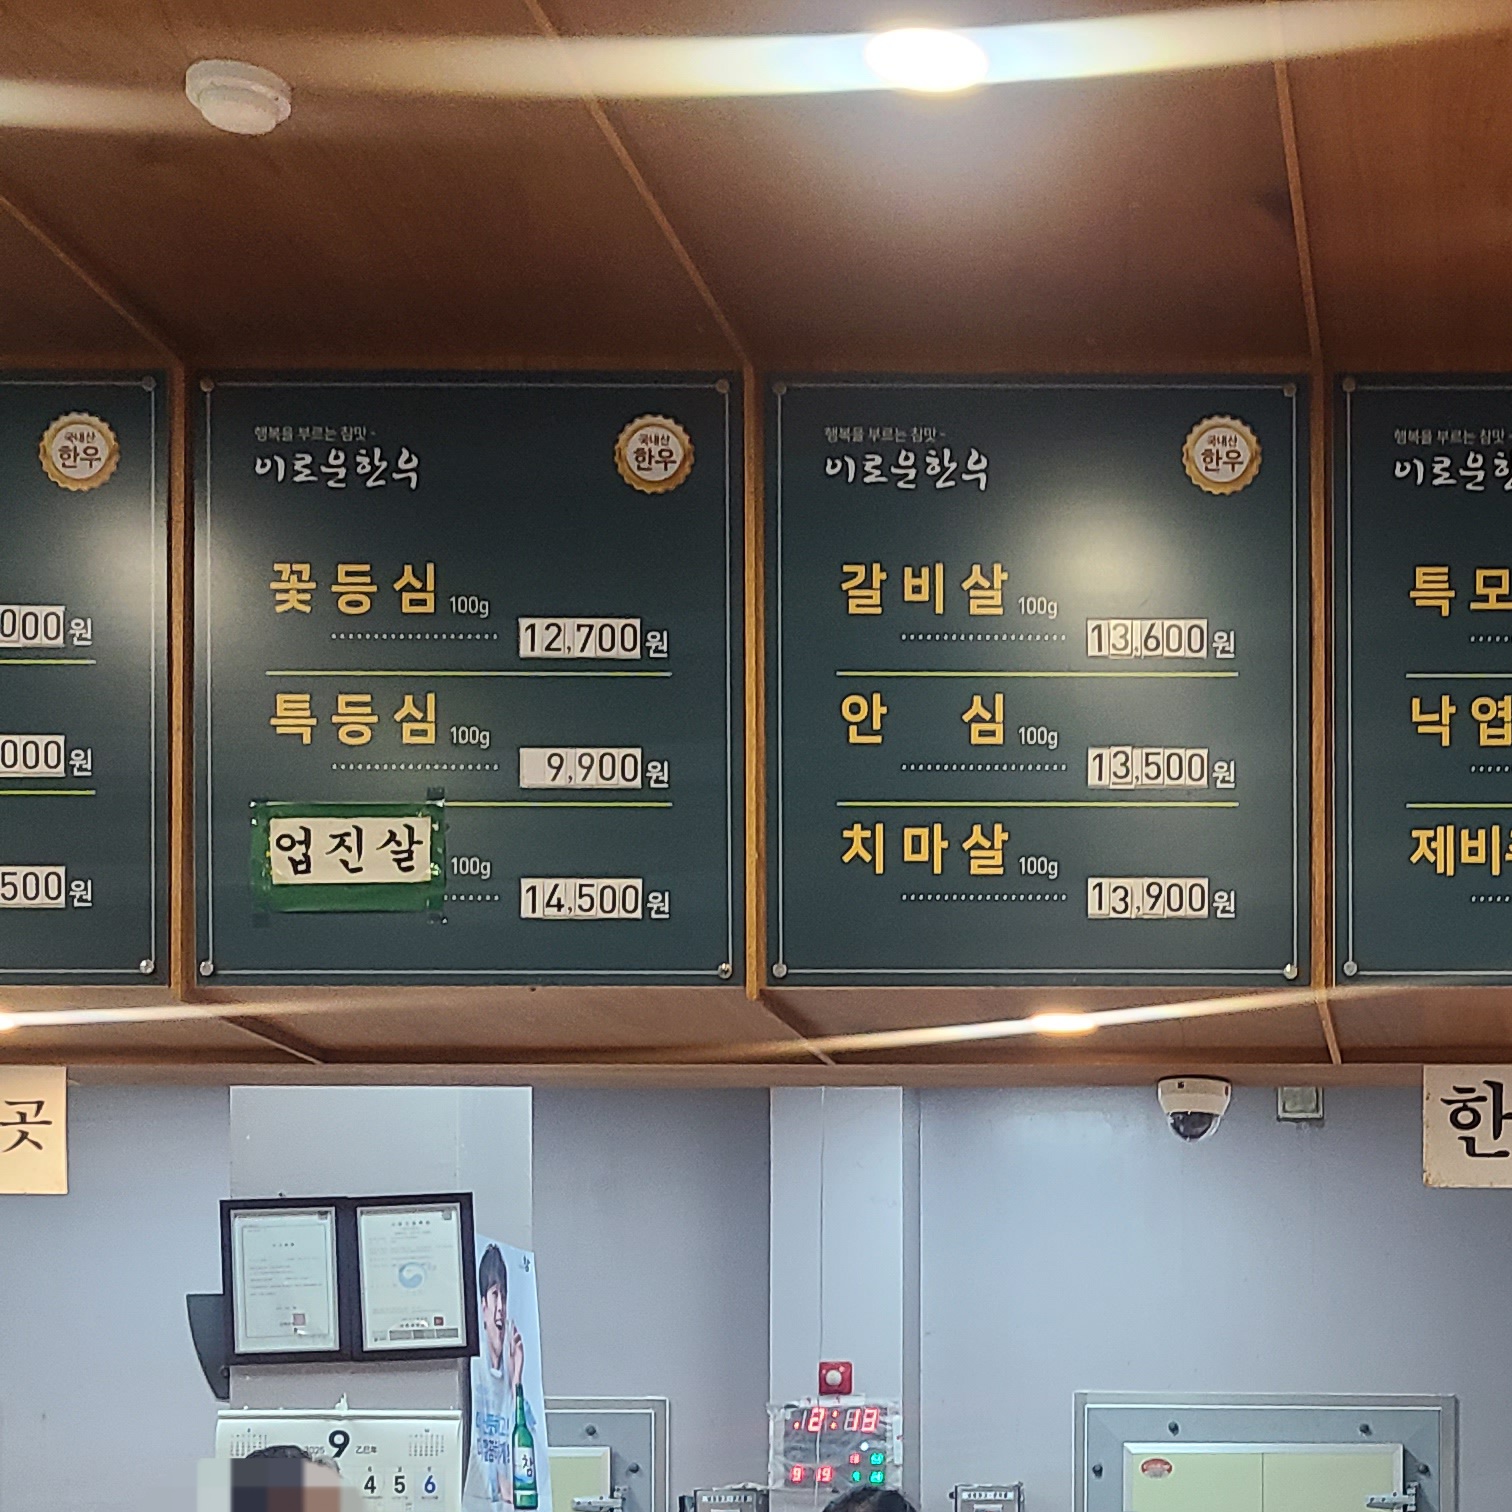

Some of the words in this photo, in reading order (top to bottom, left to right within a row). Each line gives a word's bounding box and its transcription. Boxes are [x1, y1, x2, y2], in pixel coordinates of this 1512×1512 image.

[57, 445, 101, 471] 한우
[255, 447, 420, 489] 이로운한우
[633, 447, 677, 473] 한우
[825, 448, 989, 490] 이로운한우
[1201, 446, 1245, 472] 한우
[269, 562, 437, 615] 꽃등심
[449, 595, 489, 619] 100g
[841, 563, 1008, 616] 갈비살
[1018, 596, 1058, 619] 100g
[269, 692, 437, 745] 특등심
[449, 725, 490, 750] 100g
[1018, 727, 1058, 750] 100g
[274, 825, 424, 875] 업진살
[450, 855, 491, 880] 100g
[842, 823, 1009, 875] 치마살
[1018, 857, 1059, 880] 100g
[0, 1100, 53, 1152] 곳
[328, 1429, 350, 1458] 9
[364, 1475, 376, 1494] 4
[394, 1475, 406, 1494] 5
[424, 1475, 436, 1494] 6
[522, 1454, 534, 1478] 참
